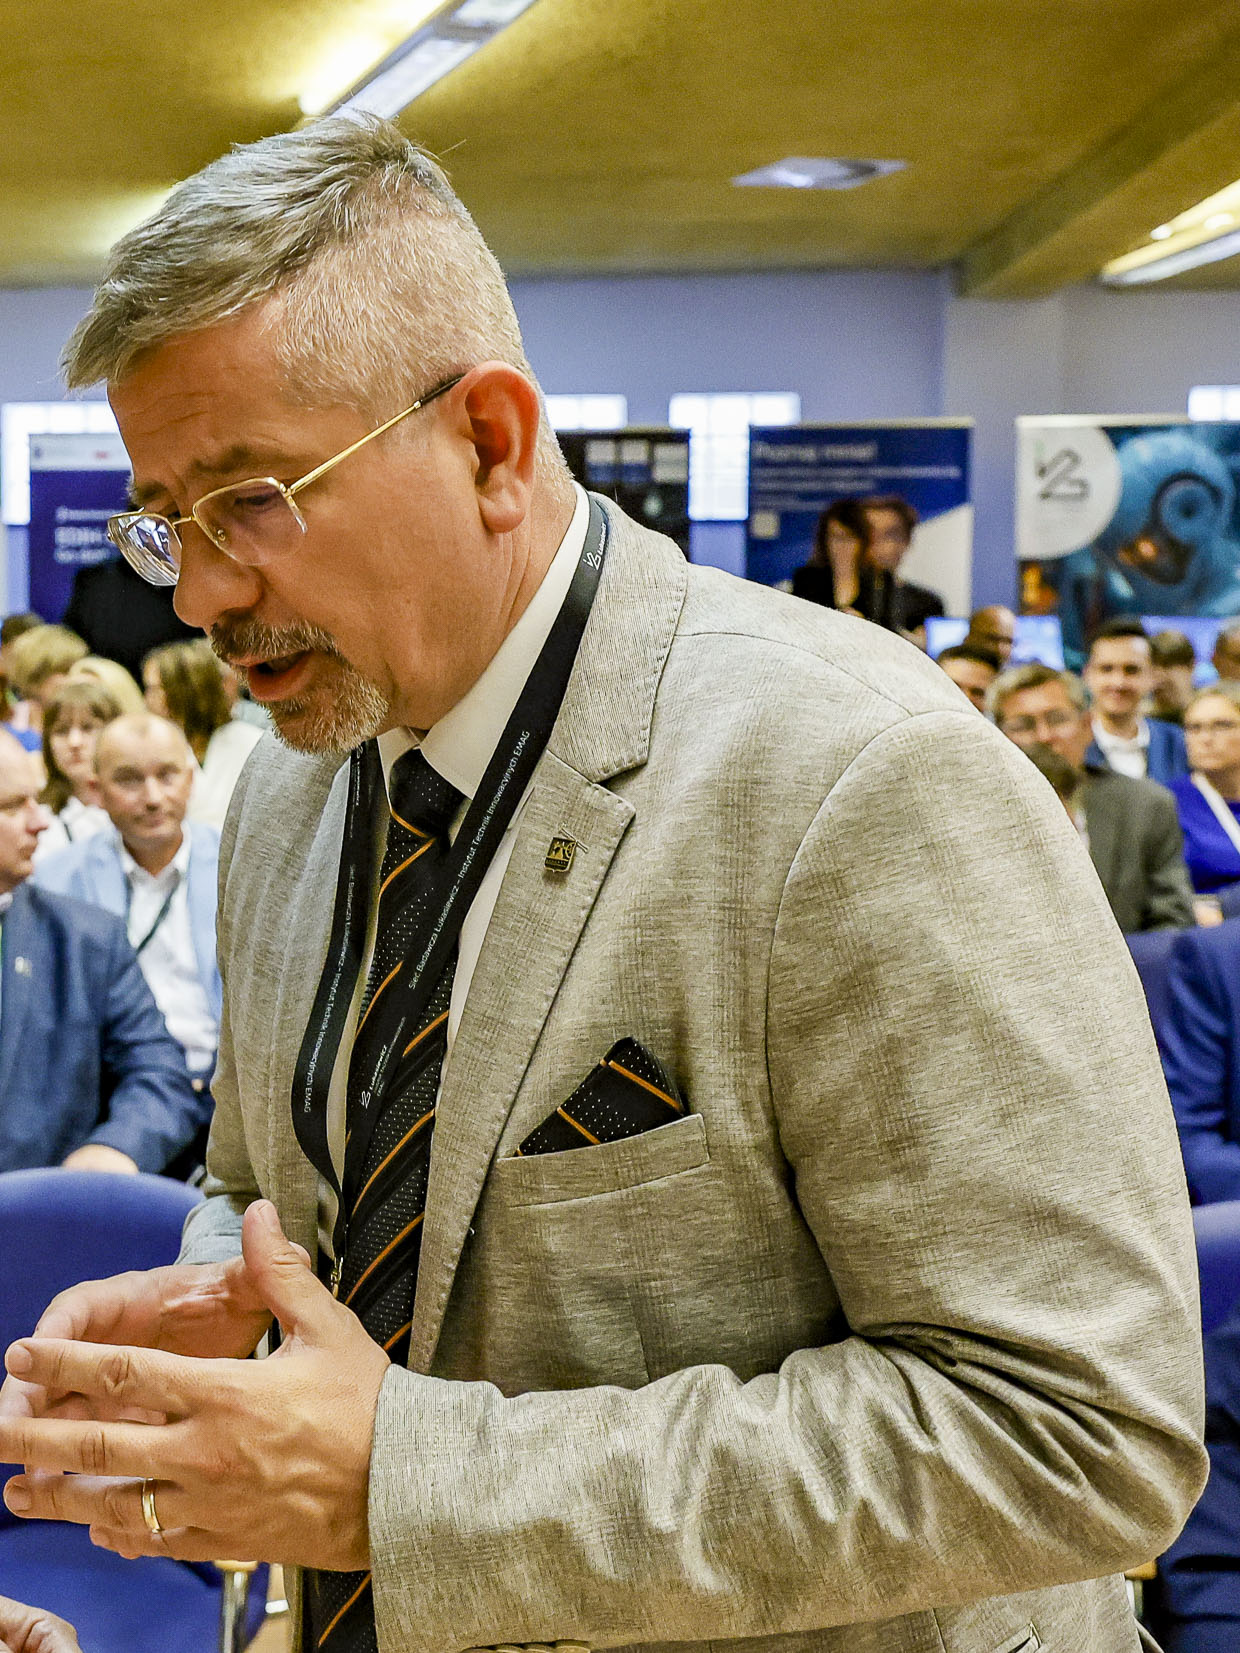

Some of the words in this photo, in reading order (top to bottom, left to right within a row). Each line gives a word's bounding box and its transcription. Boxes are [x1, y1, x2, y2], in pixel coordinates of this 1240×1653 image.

[417, 933, 438, 972] Badawcza
[458, 847, 477, 879] Instytut
[472, 815, 491, 846] Technik
[487, 756, 519, 815] Innowacyjnych
[514, 730, 530, 756] EMAG
[304, 1087, 312, 1113] EMAG
